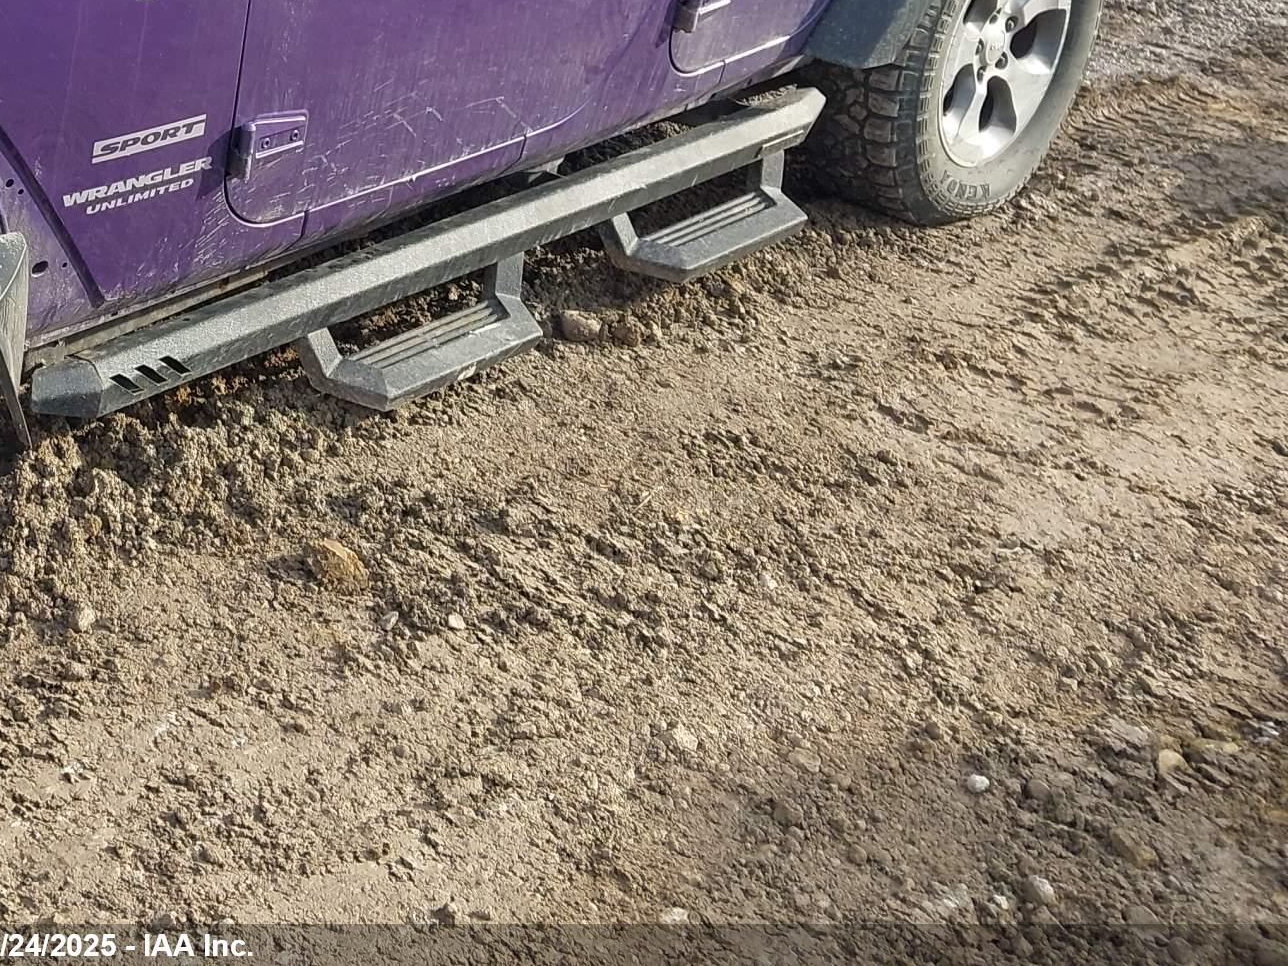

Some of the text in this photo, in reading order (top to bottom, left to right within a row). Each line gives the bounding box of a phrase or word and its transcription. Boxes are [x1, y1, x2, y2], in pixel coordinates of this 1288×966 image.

[100, 121, 205, 154] SPORT
[63, 157, 212, 207] WRANGLER
[86, 178, 193, 215] UNLIMITED
